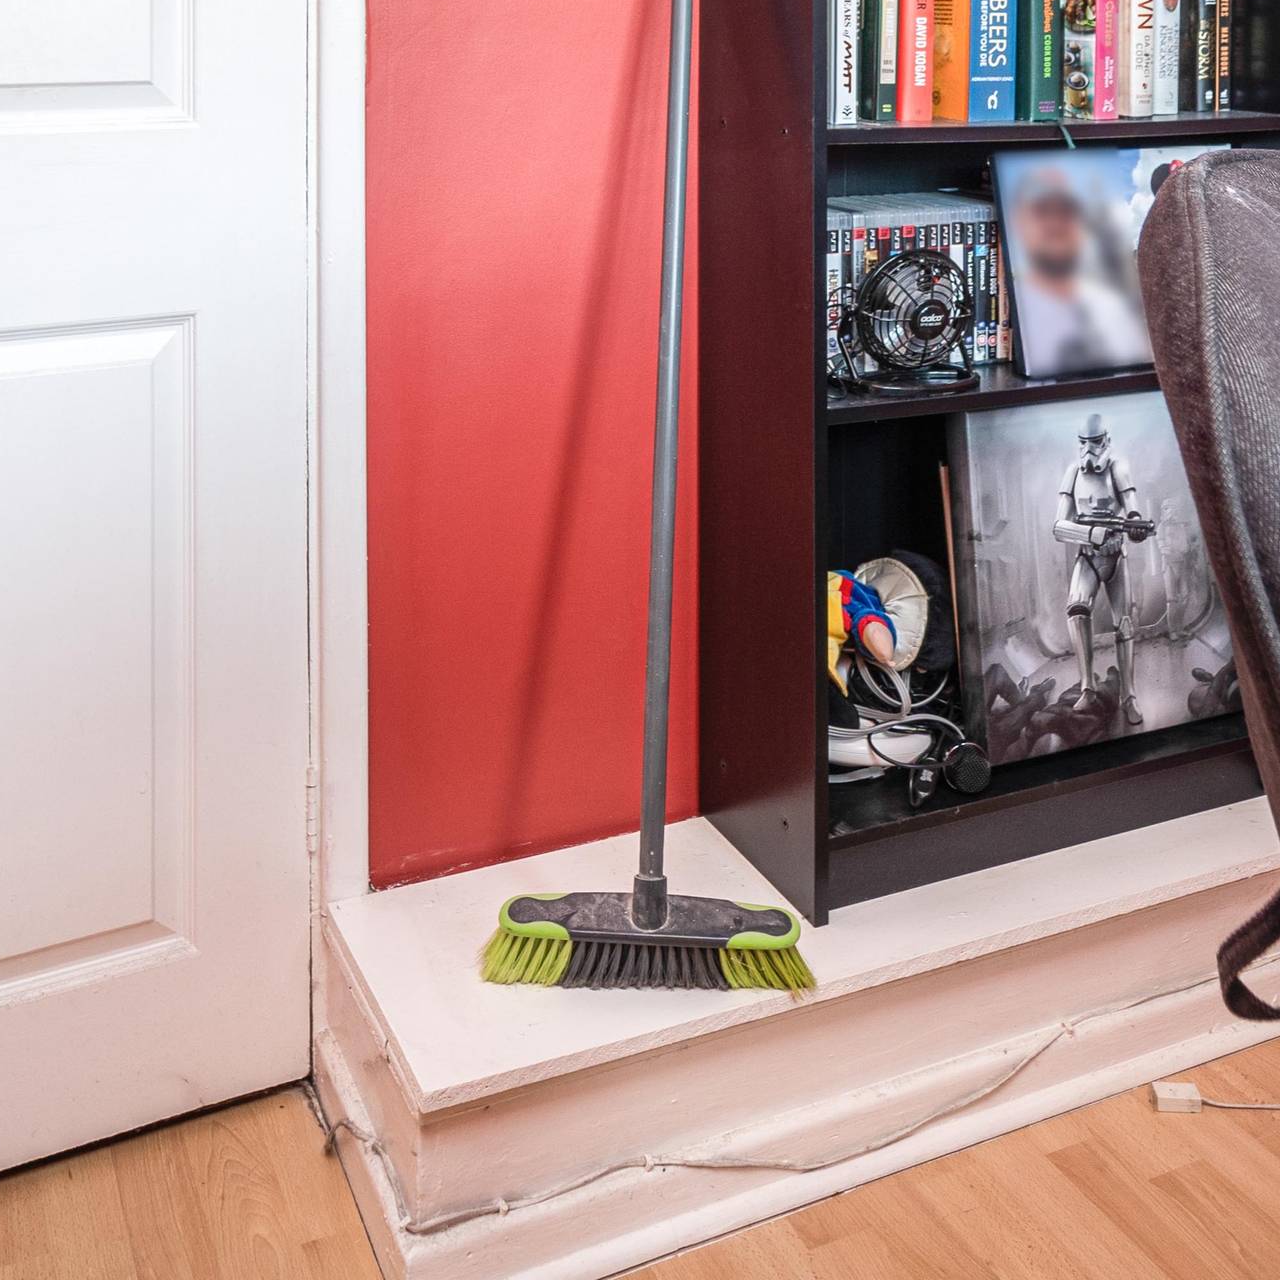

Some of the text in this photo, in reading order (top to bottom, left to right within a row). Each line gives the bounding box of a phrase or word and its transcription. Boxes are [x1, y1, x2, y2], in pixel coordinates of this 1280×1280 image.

[980, 0, 988, 31] BEFORE
[1104, 1, 1114, 47] Curries
[842, 29, 853, 39] of
[915, 16, 927, 48] DAVID
[980, 32, 988, 52] YOU
[1143, 35, 1150, 47] DA
[1220, 26, 1229, 45] MAX
[843, 40, 852, 94] MATT
[979, 53, 987, 67] DIE
[1043, 34, 1052, 78] COOKBOOK
[1135, 42, 1144, 71] CODE
[1158, 25, 1167, 79] KINGDOMS
[1199, 31, 1211, 80] STORM
[1220, 46, 1229, 77] BROOKS
[914, 51, 926, 86] KOGAN
[989, 248, 997, 277] SLEEPING
[967, 277, 974, 285] of
[989, 278, 997, 295] DOGS
[827, 268, 839, 331] HOMEFRONT
